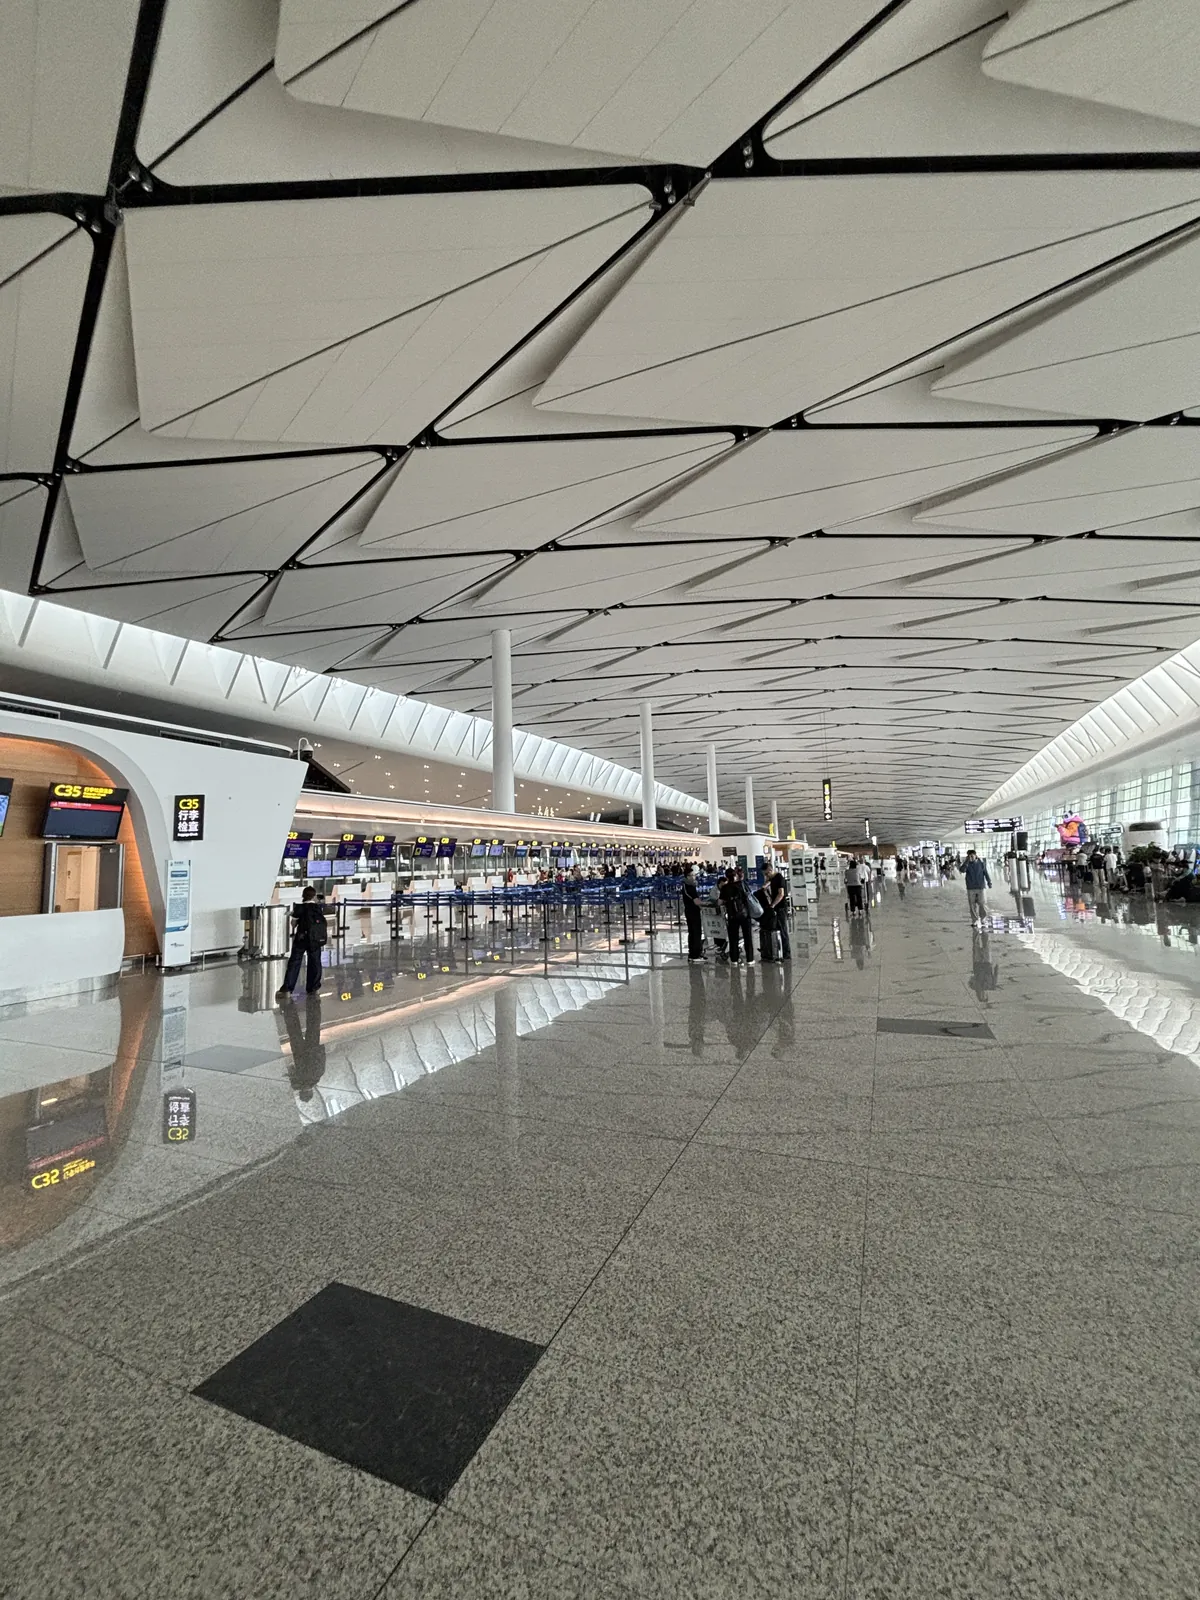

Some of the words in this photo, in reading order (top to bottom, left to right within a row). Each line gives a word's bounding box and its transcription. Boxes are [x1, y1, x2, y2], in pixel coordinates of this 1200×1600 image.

[54, 784, 82, 797] C35
[179, 798, 199, 809] C35
[178, 810, 199, 821] 行李
[177, 821, 199, 832] 检查
